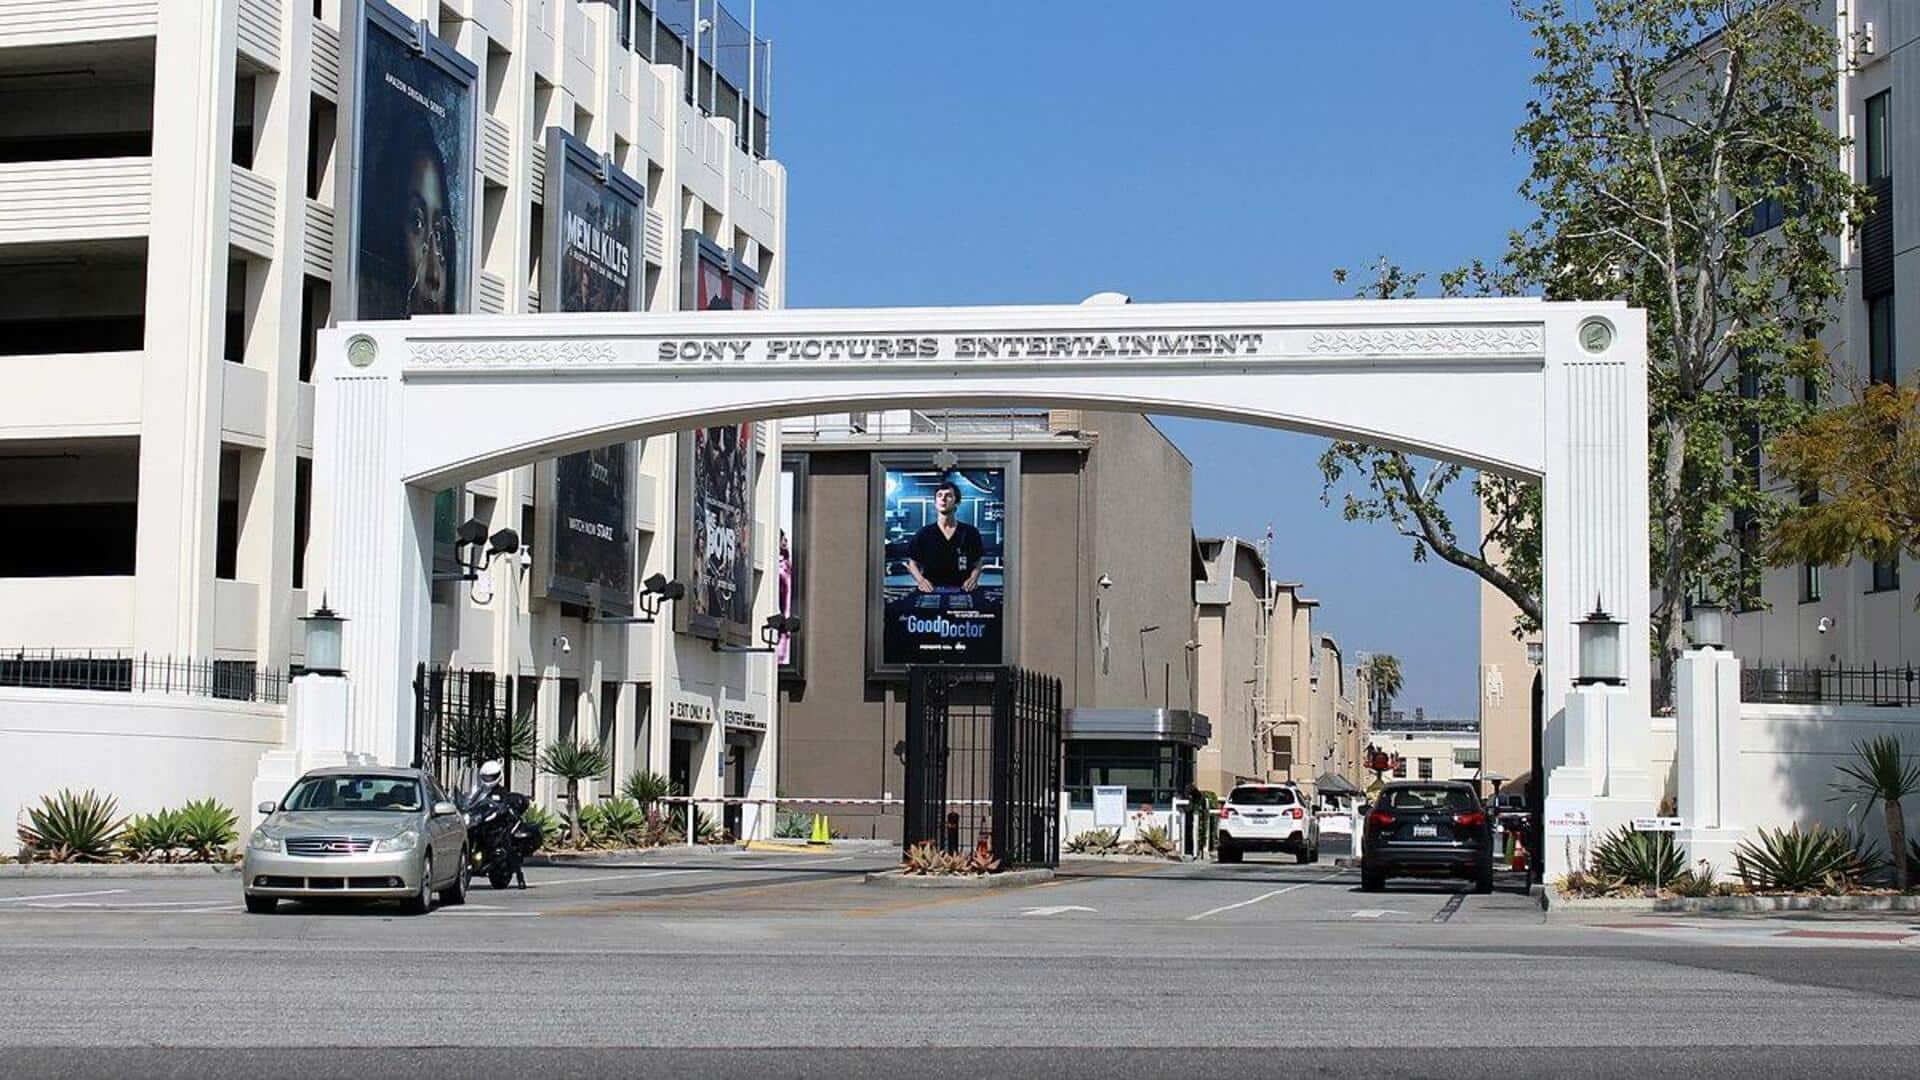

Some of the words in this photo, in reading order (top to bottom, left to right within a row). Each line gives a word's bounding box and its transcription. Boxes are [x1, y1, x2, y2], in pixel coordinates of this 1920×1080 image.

[407, 86, 430, 108] ORIGINAL
[430, 100, 446, 118] SERIES
[567, 210, 592, 255] MEN
[601, 232, 629, 277] KILTS
[658, 341, 751, 361] SONY
[766, 338, 939, 361] PICTURES
[954, 333, 1263, 358] ENTERTAINMENT
[677, 702, 689, 718] EXIT
[689, 703, 703, 719] ONLY
